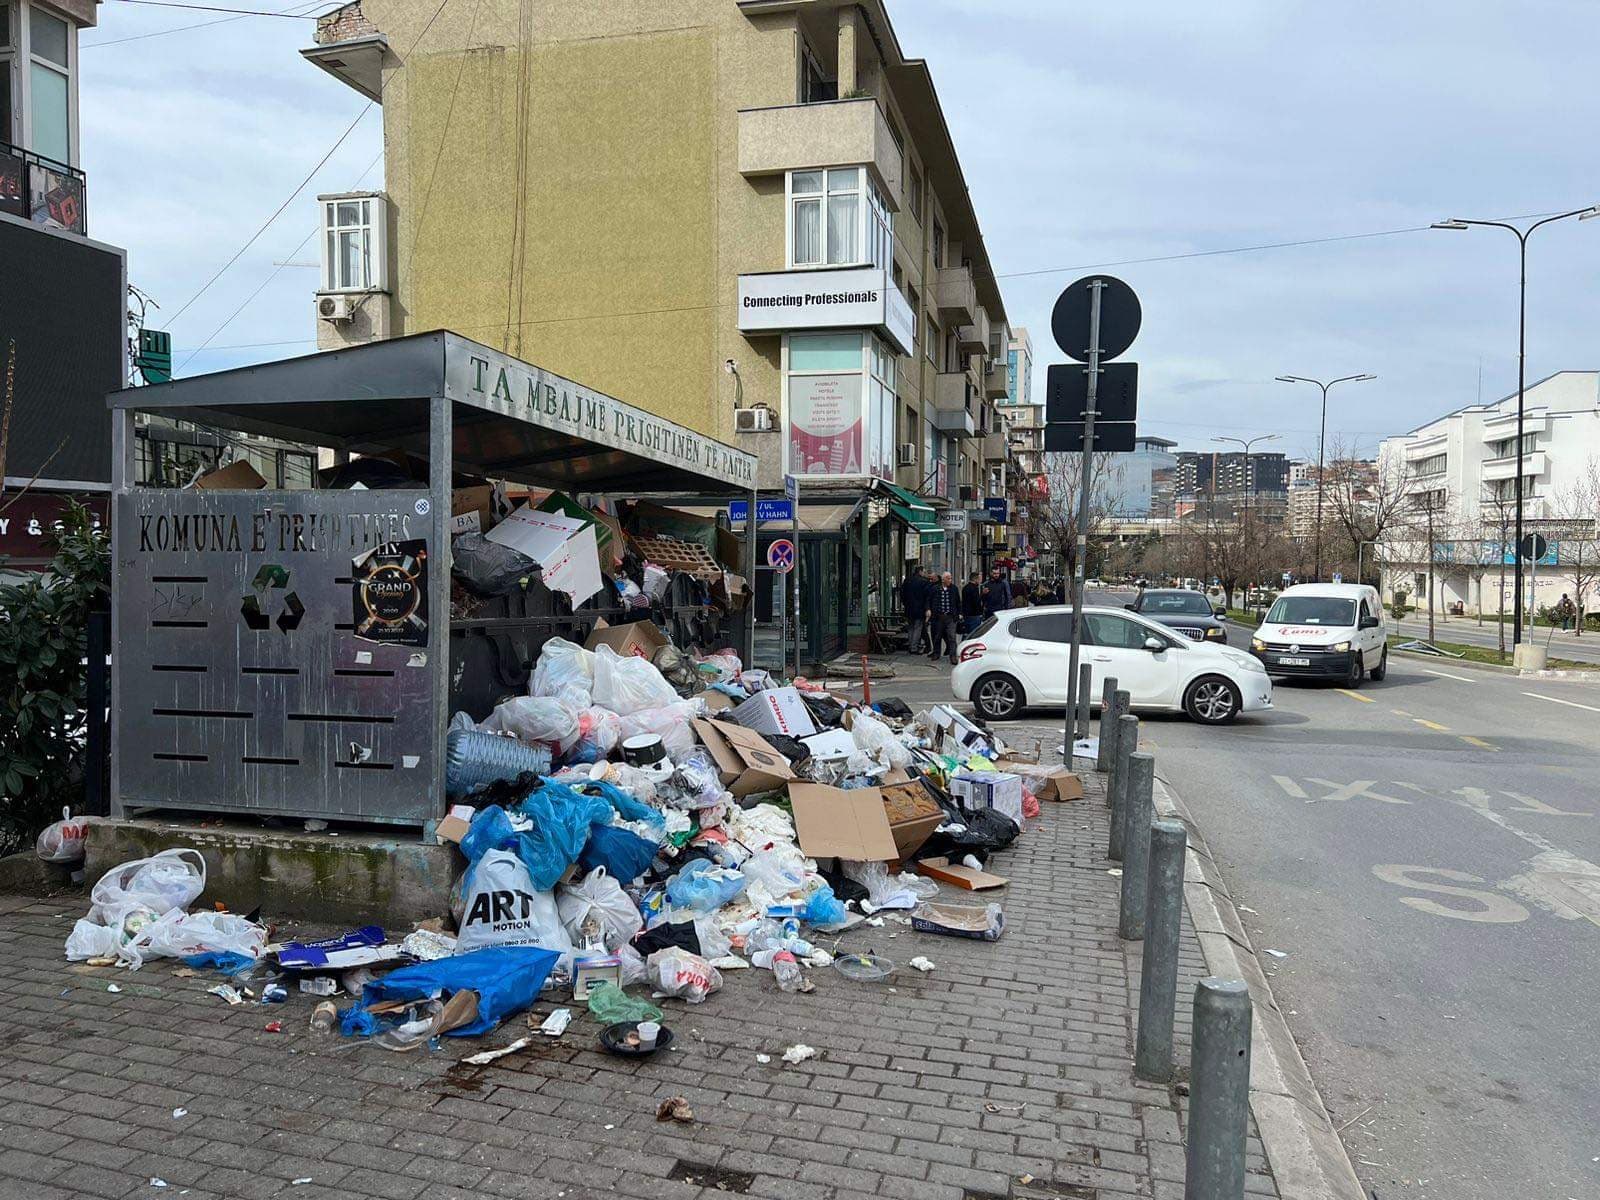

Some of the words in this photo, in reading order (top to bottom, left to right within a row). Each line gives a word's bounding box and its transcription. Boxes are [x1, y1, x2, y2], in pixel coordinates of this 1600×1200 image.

[743, 294, 803, 308] Connecting
[804, 290, 878, 306] Professionals
[766, 511, 788, 519] HAHN
[139, 514, 243, 552] KOMUNA
[278, 508, 411, 552] PRISHTINËS
[368, 582, 412, 592] GRAND
[465, 889, 534, 927] ART
[493, 920, 531, 933] MOTION
